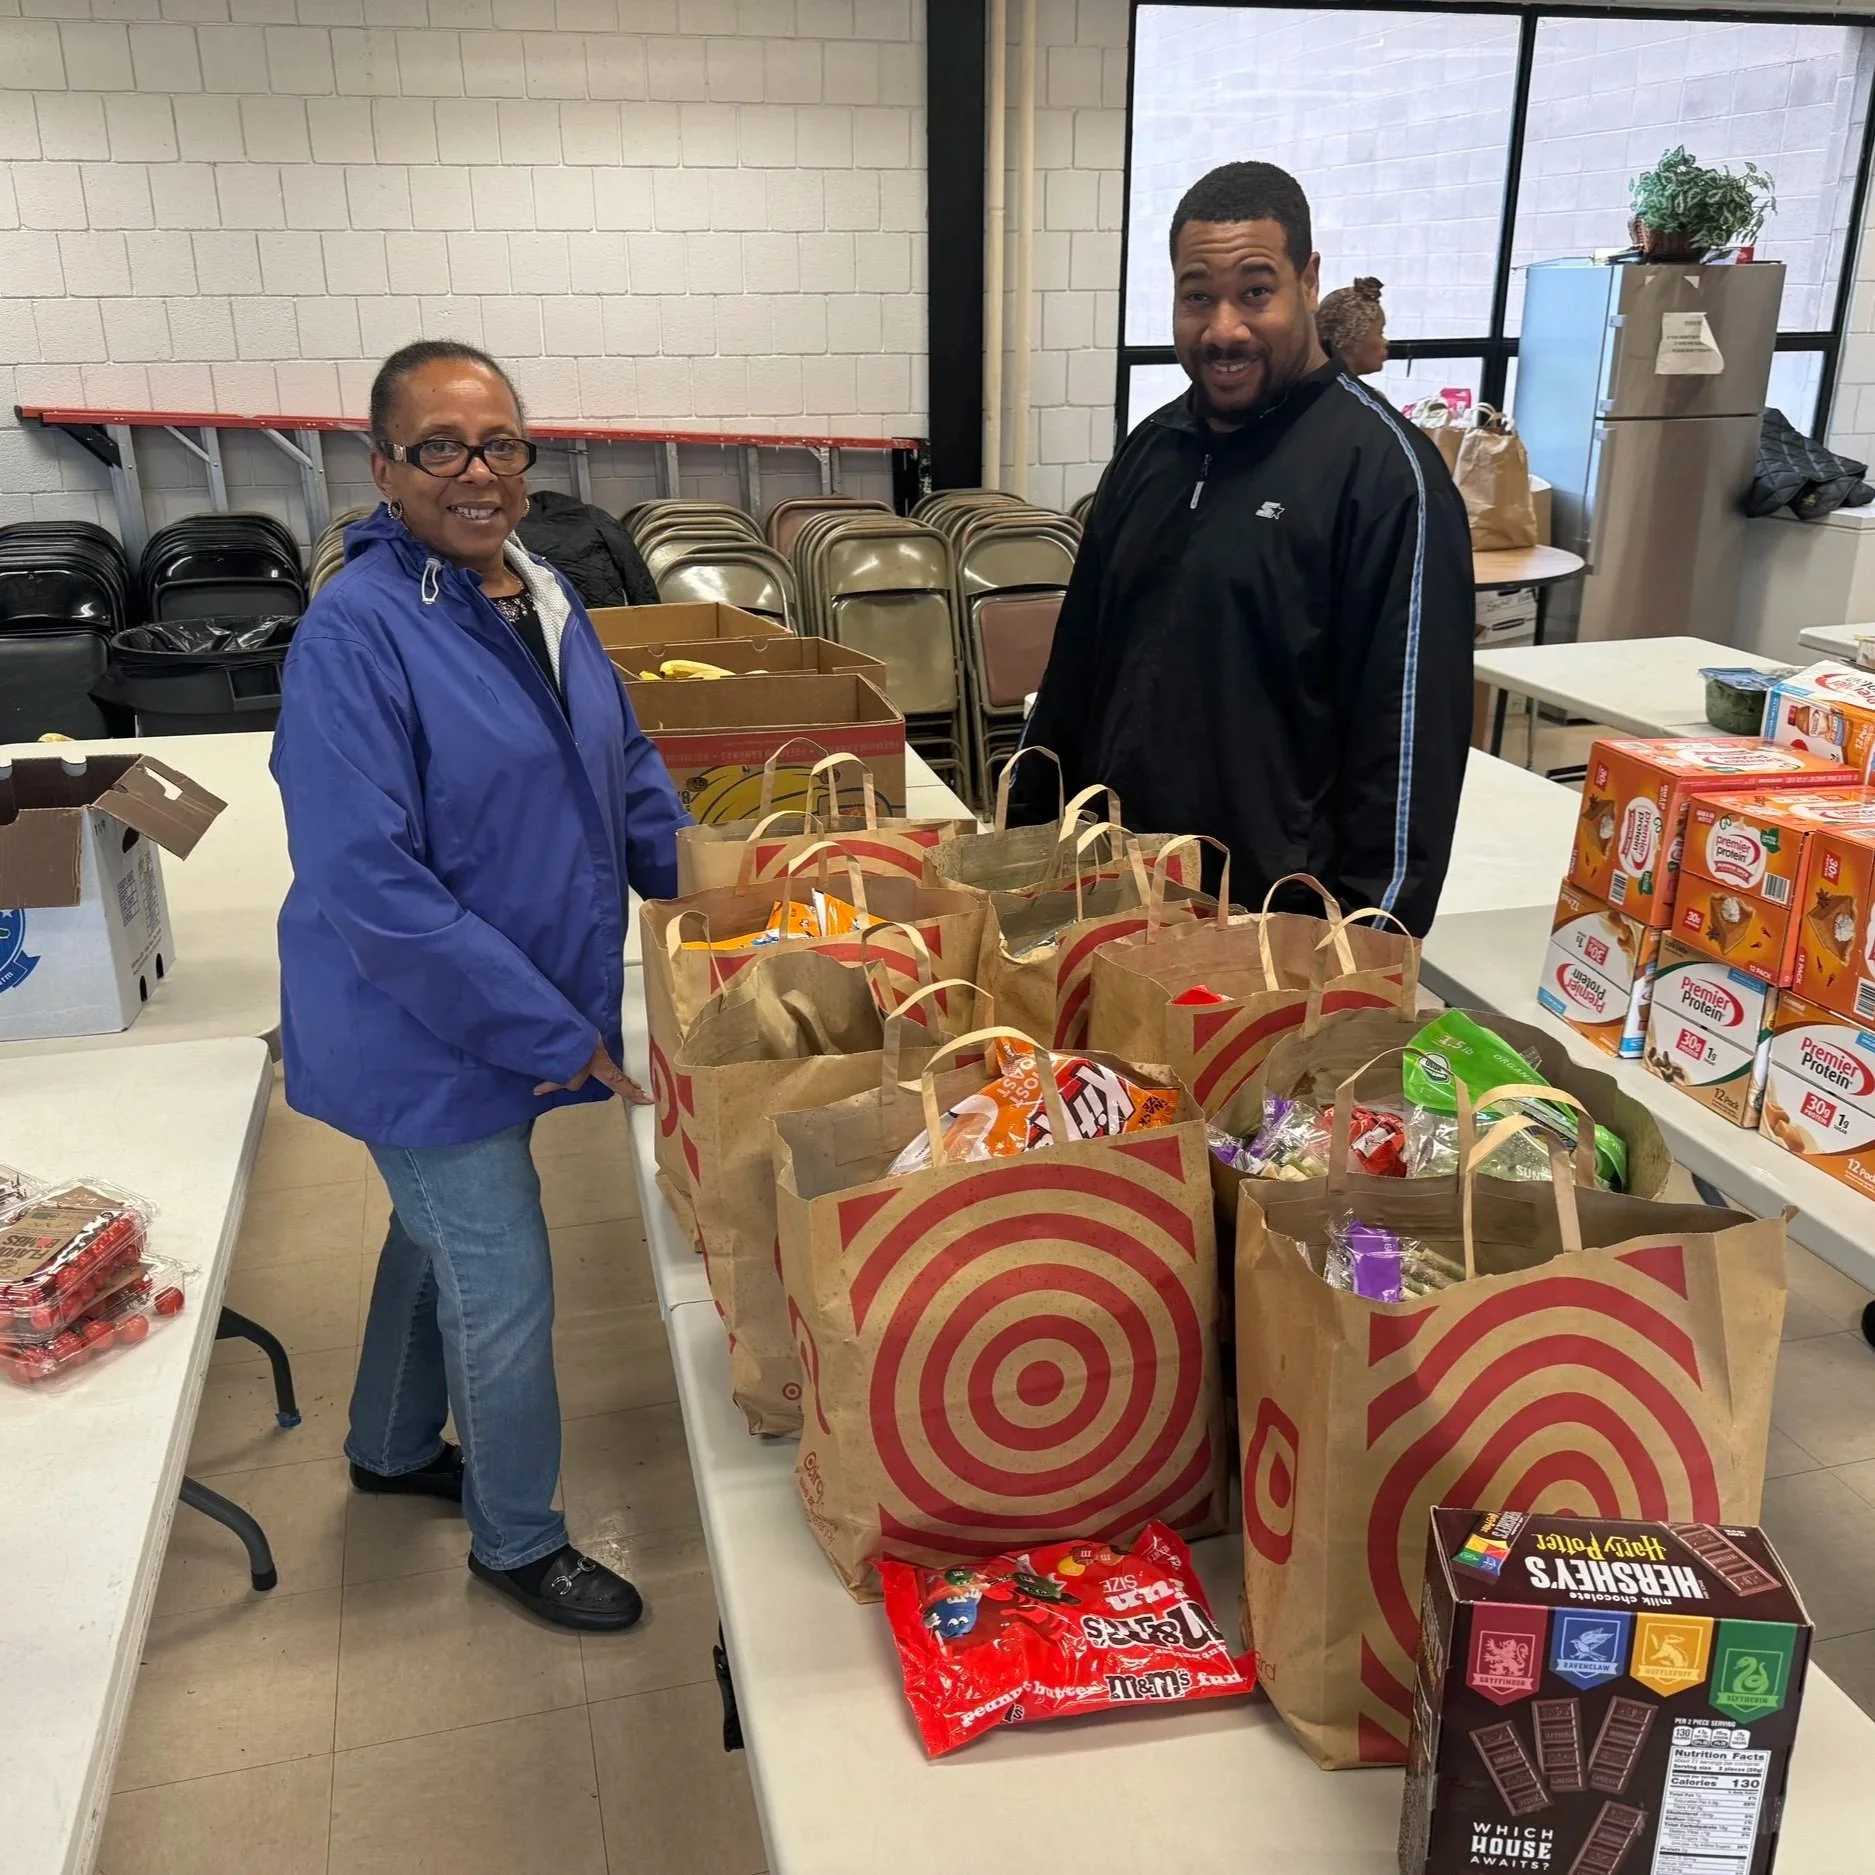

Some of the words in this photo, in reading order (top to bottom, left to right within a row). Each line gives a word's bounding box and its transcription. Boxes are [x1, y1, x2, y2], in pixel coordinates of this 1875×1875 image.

[1716, 835, 1751, 854] premier
[1716, 846, 1748, 863] protein
[1572, 968, 1607, 1000] Protein
[1750, 964, 1756, 974] 12
[1756, 968, 1772, 979] PACK
[1568, 978, 1606, 1014] Premier
[1680, 976, 1730, 1011] Premier
[1682, 990, 1722, 1022] Protein
[1681, 1032, 1701, 1052] 30g
[1708, 1047, 1717, 1061] 1g
[1800, 1036, 1860, 1079] Premier
[1493, 1054, 1535, 1083] ORGANI
[1802, 1052, 1850, 1090] Protein
[1714, 1088, 1726, 1101] 12
[1806, 1096, 1831, 1119] 30g
[1838, 1113, 1850, 1129] 1g
[1848, 1158, 1860, 1174] 12
[1860, 1168, 1875, 1183] Pac
[1532, 1531, 1605, 1560] Potter
[1604, 1535, 1668, 1561] Harry
[1099, 1574, 1138, 1593] SIZE
[1524, 1556, 1704, 1600] HERSHEY'S
[1570, 1592, 1637, 1605] chocolate
[1642, 1596, 1672, 1607] milk
[1562, 1661, 1611, 1672] RAVENCLAW
[1676, 1728, 1691, 1737] 130
[1674, 1749, 1728, 1760] Nutrition
[1732, 1752, 1764, 1761] Facts
[1671, 1778, 1717, 1787] Calories
[1732, 1780, 1760, 1788] 130
[1472, 1822, 1554, 1840] WHICH
[1471, 1835, 1552, 1860] HOUSE
[1470, 1856, 1550, 1871] AWAITS?
